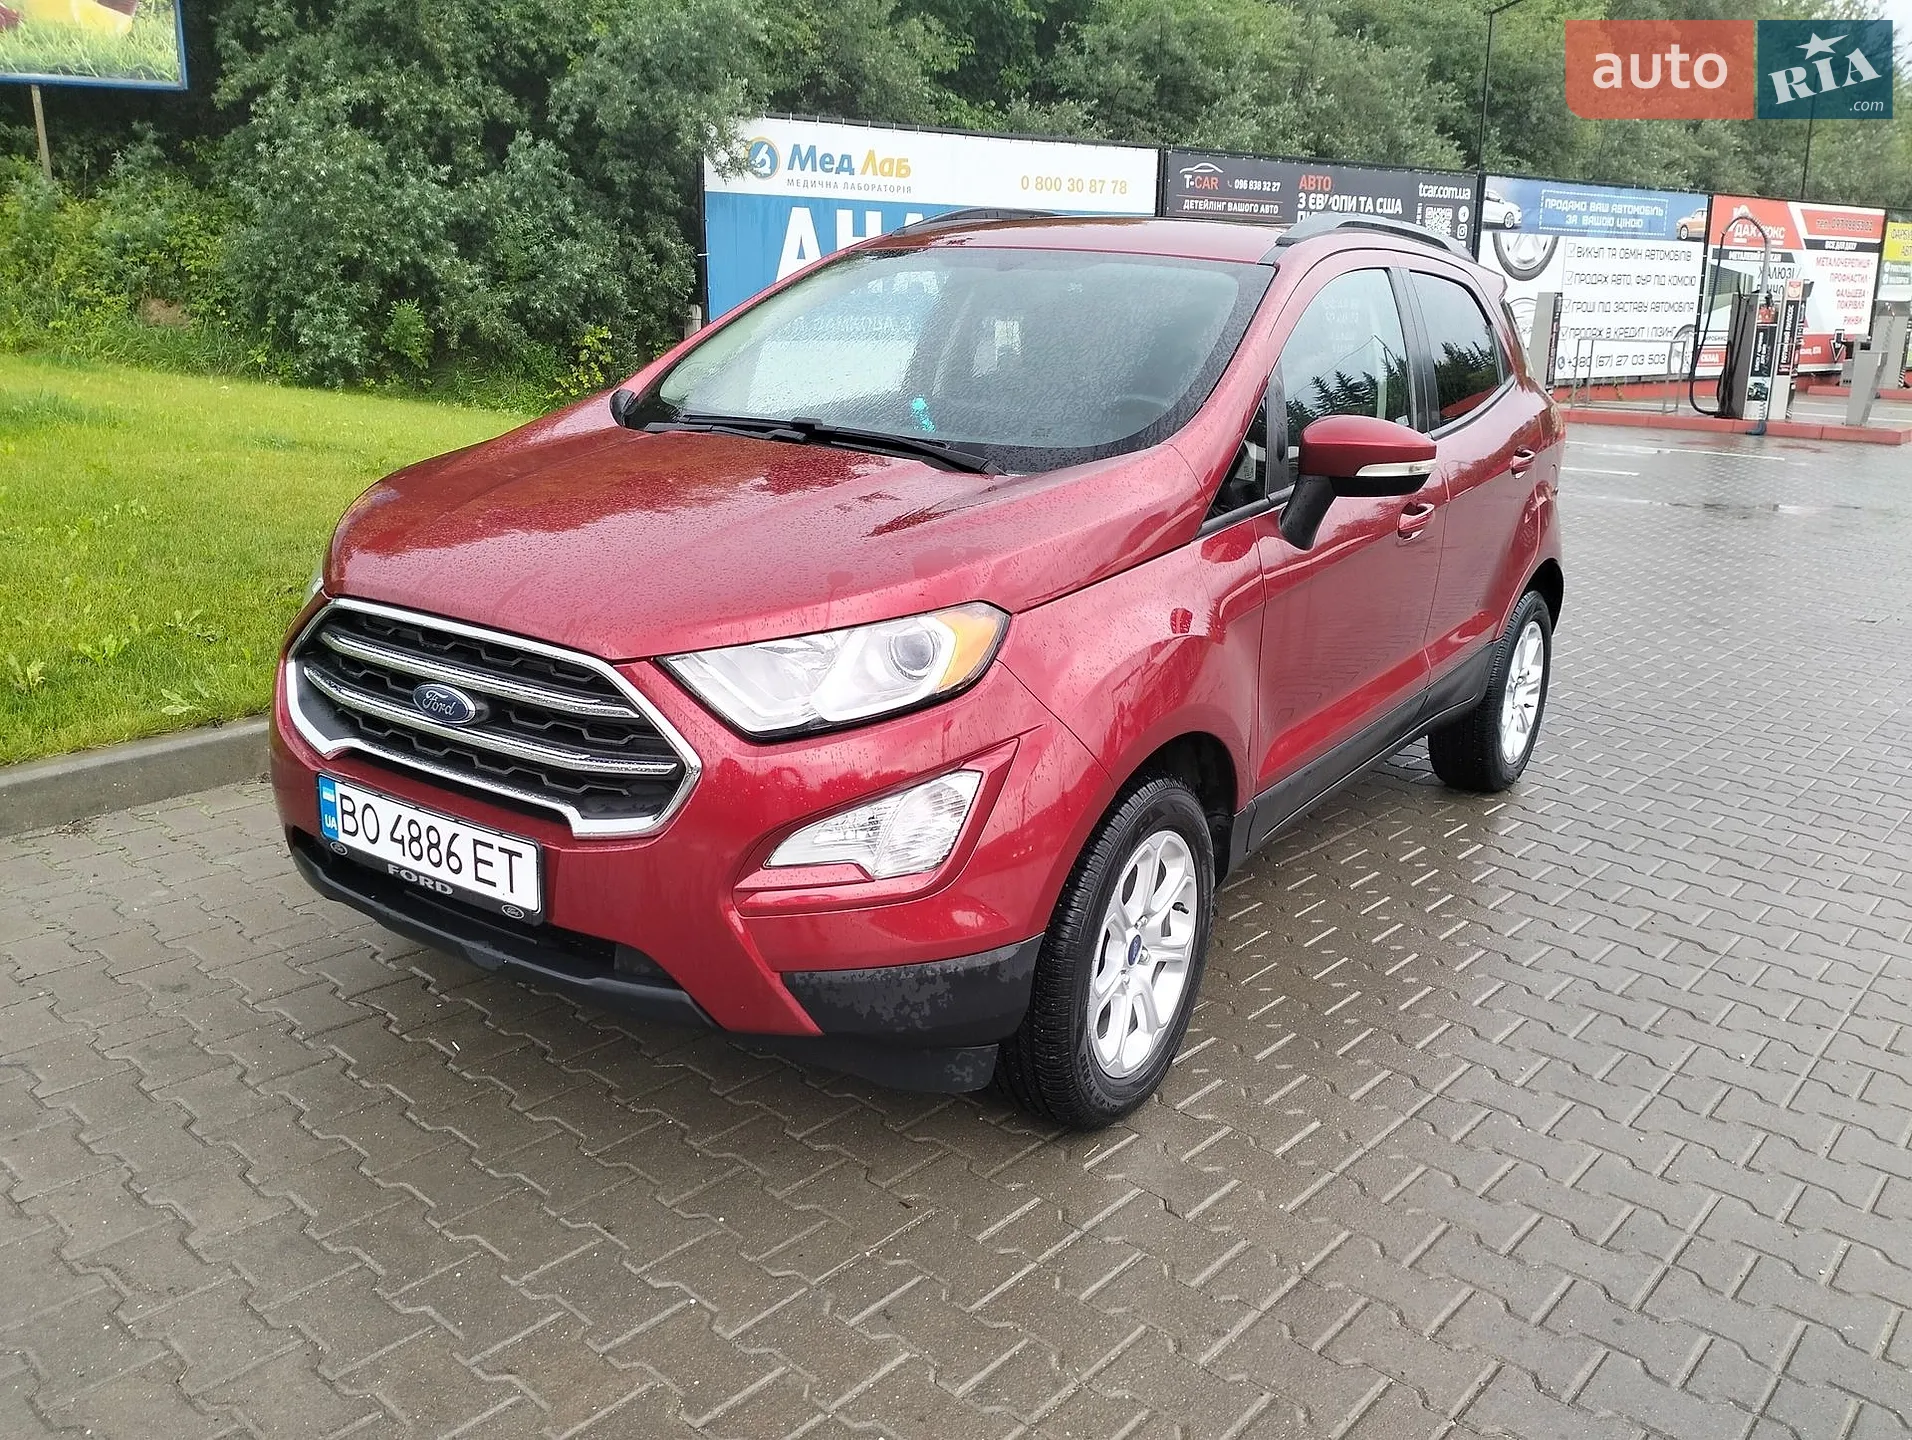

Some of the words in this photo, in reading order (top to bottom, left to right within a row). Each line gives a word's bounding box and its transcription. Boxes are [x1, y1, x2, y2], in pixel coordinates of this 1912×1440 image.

[787, 143, 855, 176] Мед
[860, 149, 912, 179] Лаб
[786, 178, 839, 190] МЕДИЧНА
[842, 181, 912, 194] ЛАБОРАТОРІЯ
[1021, 175, 1030, 191] 0
[1035, 176, 1062, 192] 800
[1067, 177, 1084, 193] 30
[1089, 179, 1106, 194] 87
[1111, 180, 1128, 195] 78
[1262, 180, 1271, 191] 32
[1271, 181, 1281, 192] 27
[1298, 174, 1332, 191] АВТО
[1418, 182, 1471, 200] tcar.com.ua
[1183, 199, 1226, 211] ДЕТЕЙЛІНГ
[1227, 201, 1259, 213] ВАШОГО
[1260, 204, 1279, 214] АВТО
[1297, 192, 1307, 209] З
[1358, 196, 1374, 213] ТА
[1376, 197, 1403, 214] США
[1544, 198, 1587, 212] ПРОДАМО
[1589, 201, 1610, 213] ВАШ
[1610, 203, 1664, 217] АВТОМОБІЛЬ
[1565, 214, 1578, 225] ЗА
[1581, 215, 1614, 227] ВАШОЮ
[1757, 225, 1786, 239] ЮКС
[775, 206, 924, 281] АН
[1576, 246, 1605, 259] ВИКУП
[1607, 247, 1617, 259] ТА
[1613, 301, 1649, 313] ЗАСТАВУ
[1615, 354, 1629, 367] 27
[422, 690, 456, 716] Ford
[324, 813, 338, 831] UA
[339, 793, 380, 845] BO
[390, 814, 463, 876] 4886
[472, 838, 523, 894] ET
[387, 863, 454, 896] FORD
